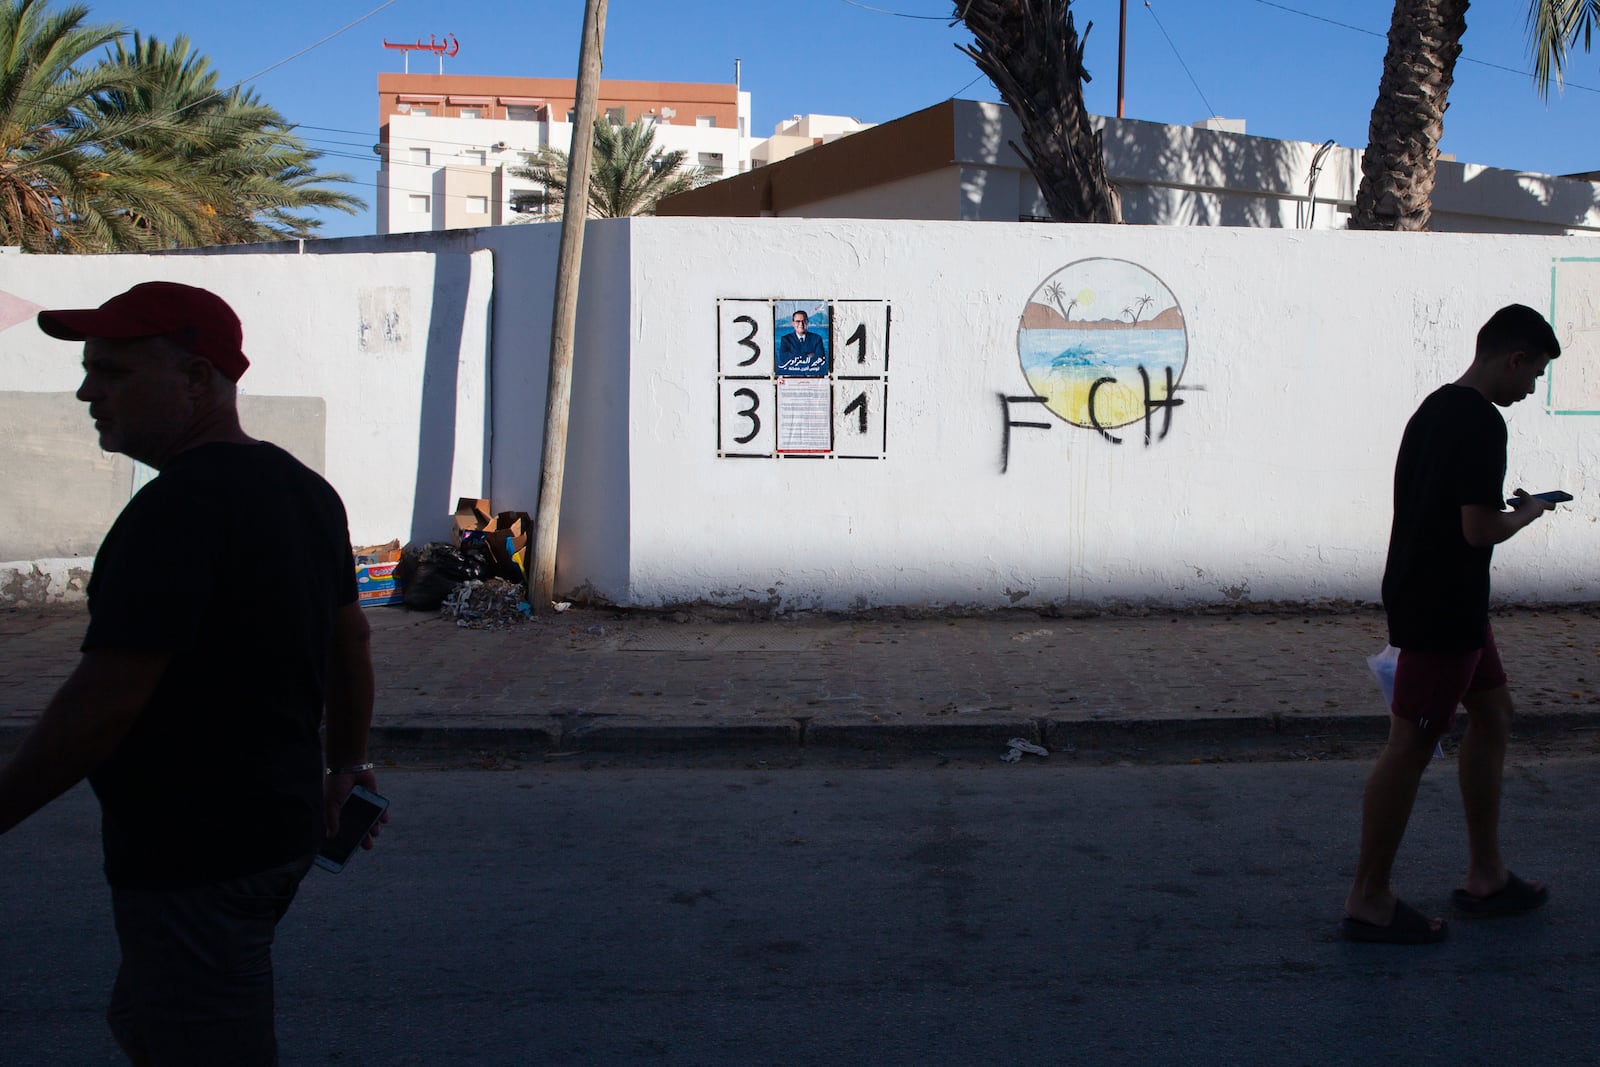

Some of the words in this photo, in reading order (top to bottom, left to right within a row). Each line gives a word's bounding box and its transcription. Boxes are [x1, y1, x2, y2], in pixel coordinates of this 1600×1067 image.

[732, 315, 761, 367] 3
[845, 323, 867, 364] 1
[733, 387, 761, 444] 3
[843, 391, 868, 434] 1
